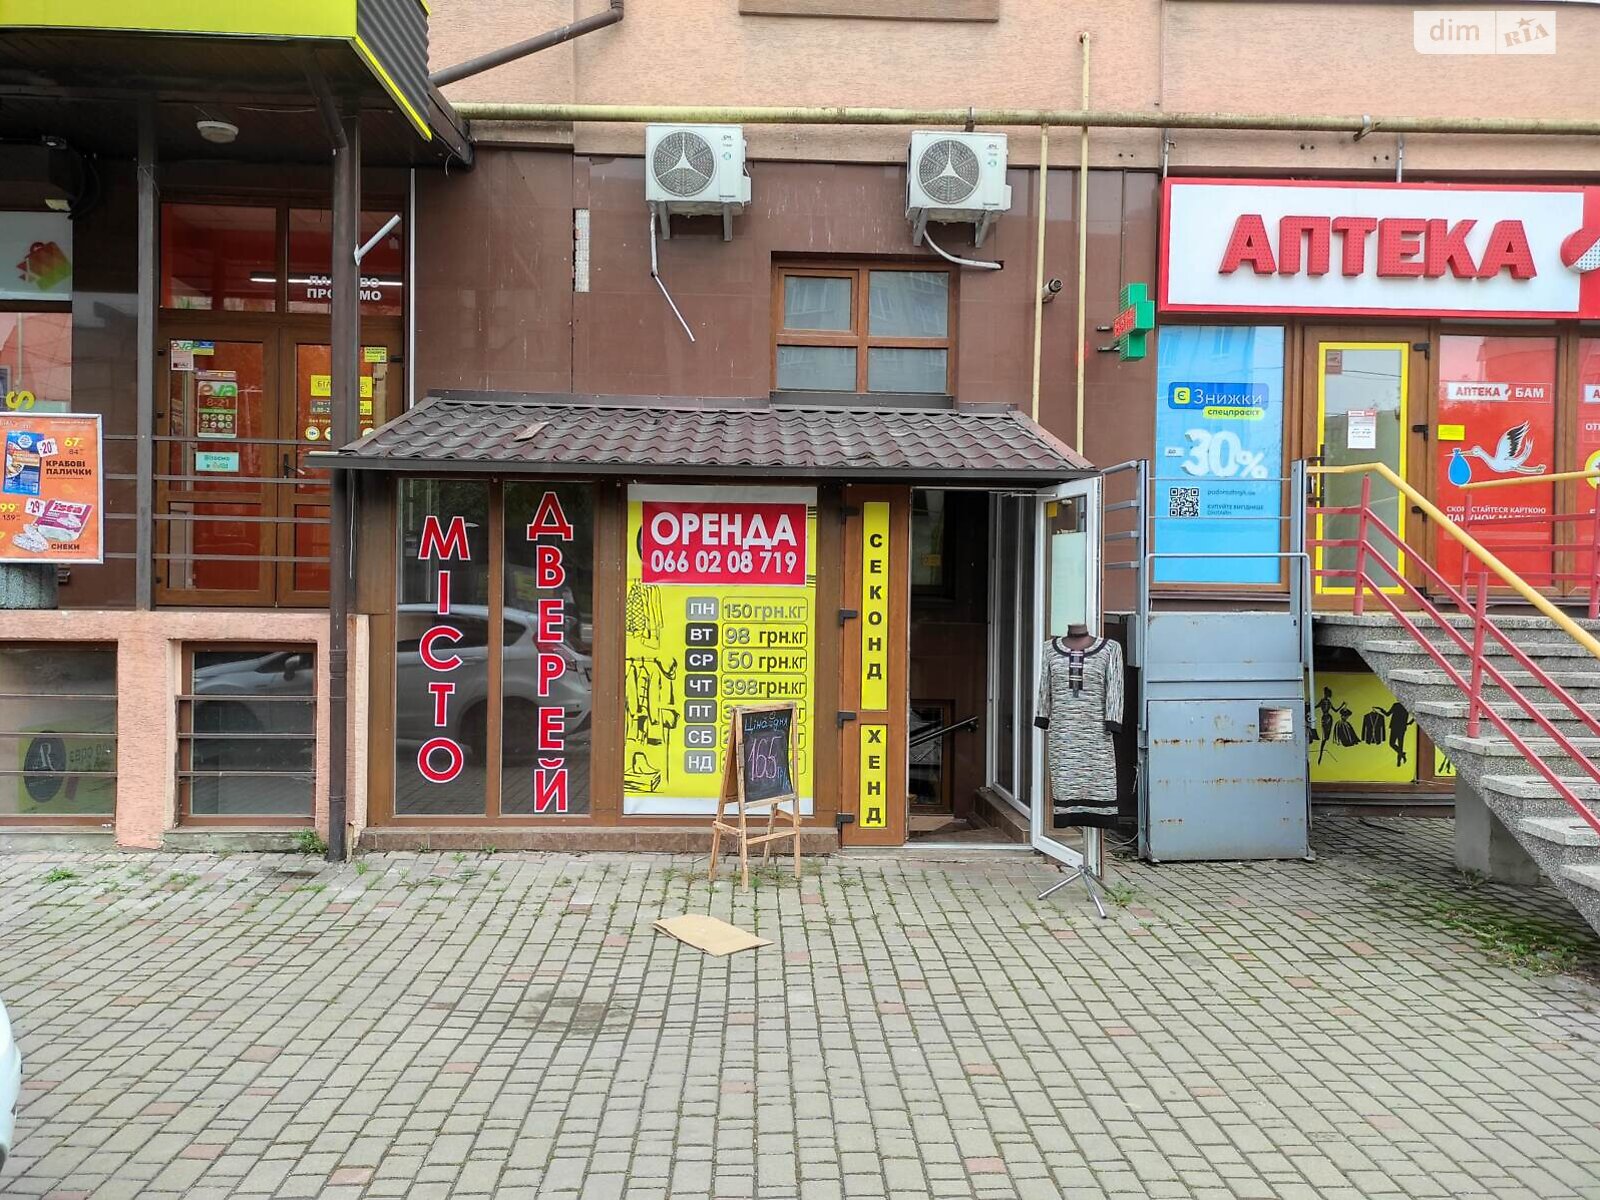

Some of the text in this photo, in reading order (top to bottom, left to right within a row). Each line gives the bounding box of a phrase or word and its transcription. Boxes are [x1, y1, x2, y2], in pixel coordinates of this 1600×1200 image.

[1218, 213, 1538, 279] АПТЕКА
[1456, 386, 1544, 399] АПТЕКА БАМ
[64, 437, 80, 447] 67
[46, 460, 86, 468] КРАБОВІ
[46, 468, 92, 476] ПАЛИЧКИ
[650, 511, 797, 550] ОРЕНДА
[51, 543, 80, 551] СНЕКИ
[651, 549, 797, 574] 066 02 08 719
[690, 602, 715, 615] ПН
[867, 533, 883, 681] СЕКОНД
[690, 629, 713, 641] ВТ
[725, 627, 750, 644] 98
[418, 515, 471, 783] МІСТО
[526, 491, 573, 813] ДВЕРЕЙ
[689, 654, 714, 667] СР
[727, 651, 753, 669] 50
[690, 679, 713, 692] ЧТ
[688, 705, 712, 718] ПТ
[688, 730, 713, 744] СБ
[688, 755, 713, 772] НД
[748, 736, 782, 782] 165
[866, 728, 882, 825] ХЕНД
